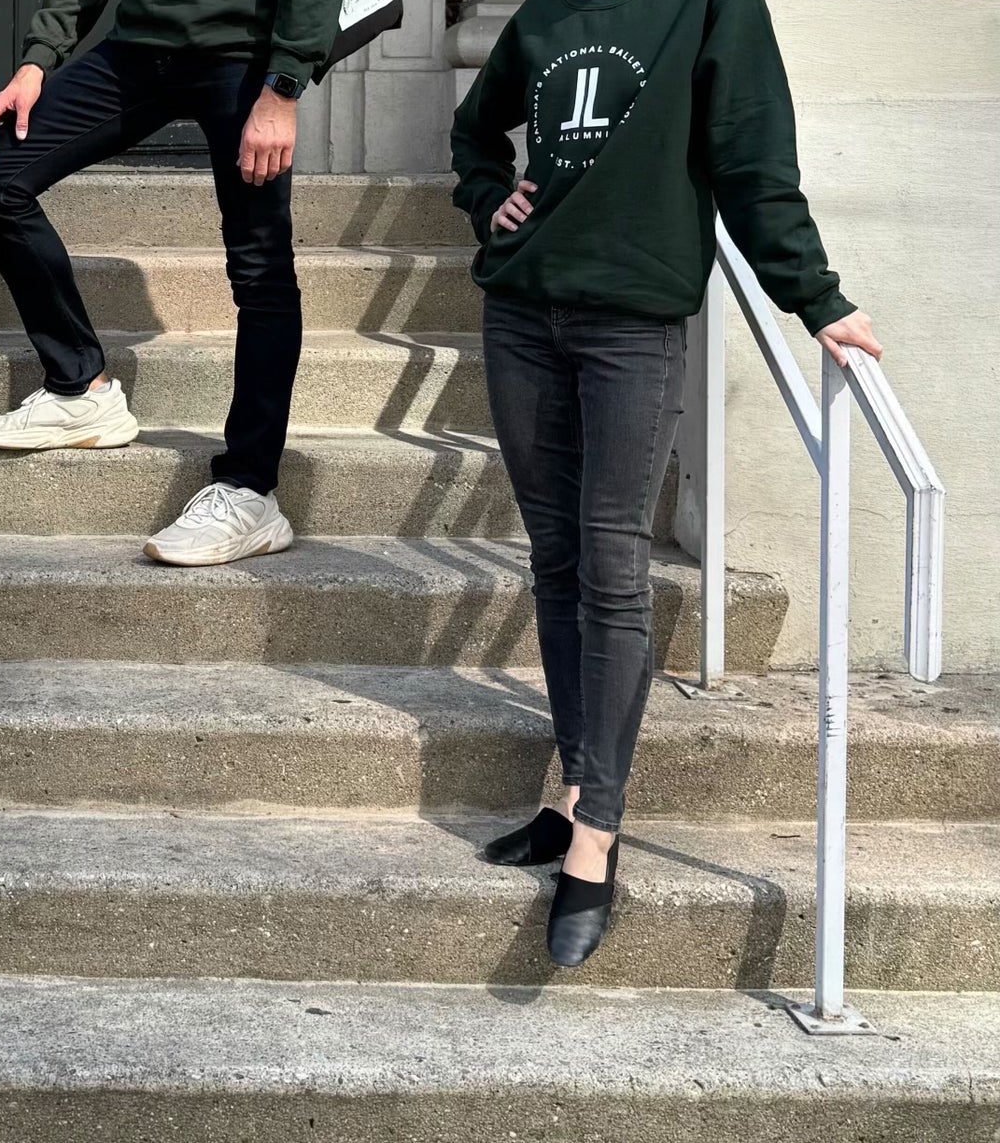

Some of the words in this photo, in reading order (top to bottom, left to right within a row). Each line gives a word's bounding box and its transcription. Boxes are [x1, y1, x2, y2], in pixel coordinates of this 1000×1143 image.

[542, 45, 603, 77] NATIONAL
[609, 46, 645, 74] BALLET
[558, 130, 609, 142] ALUMNI
